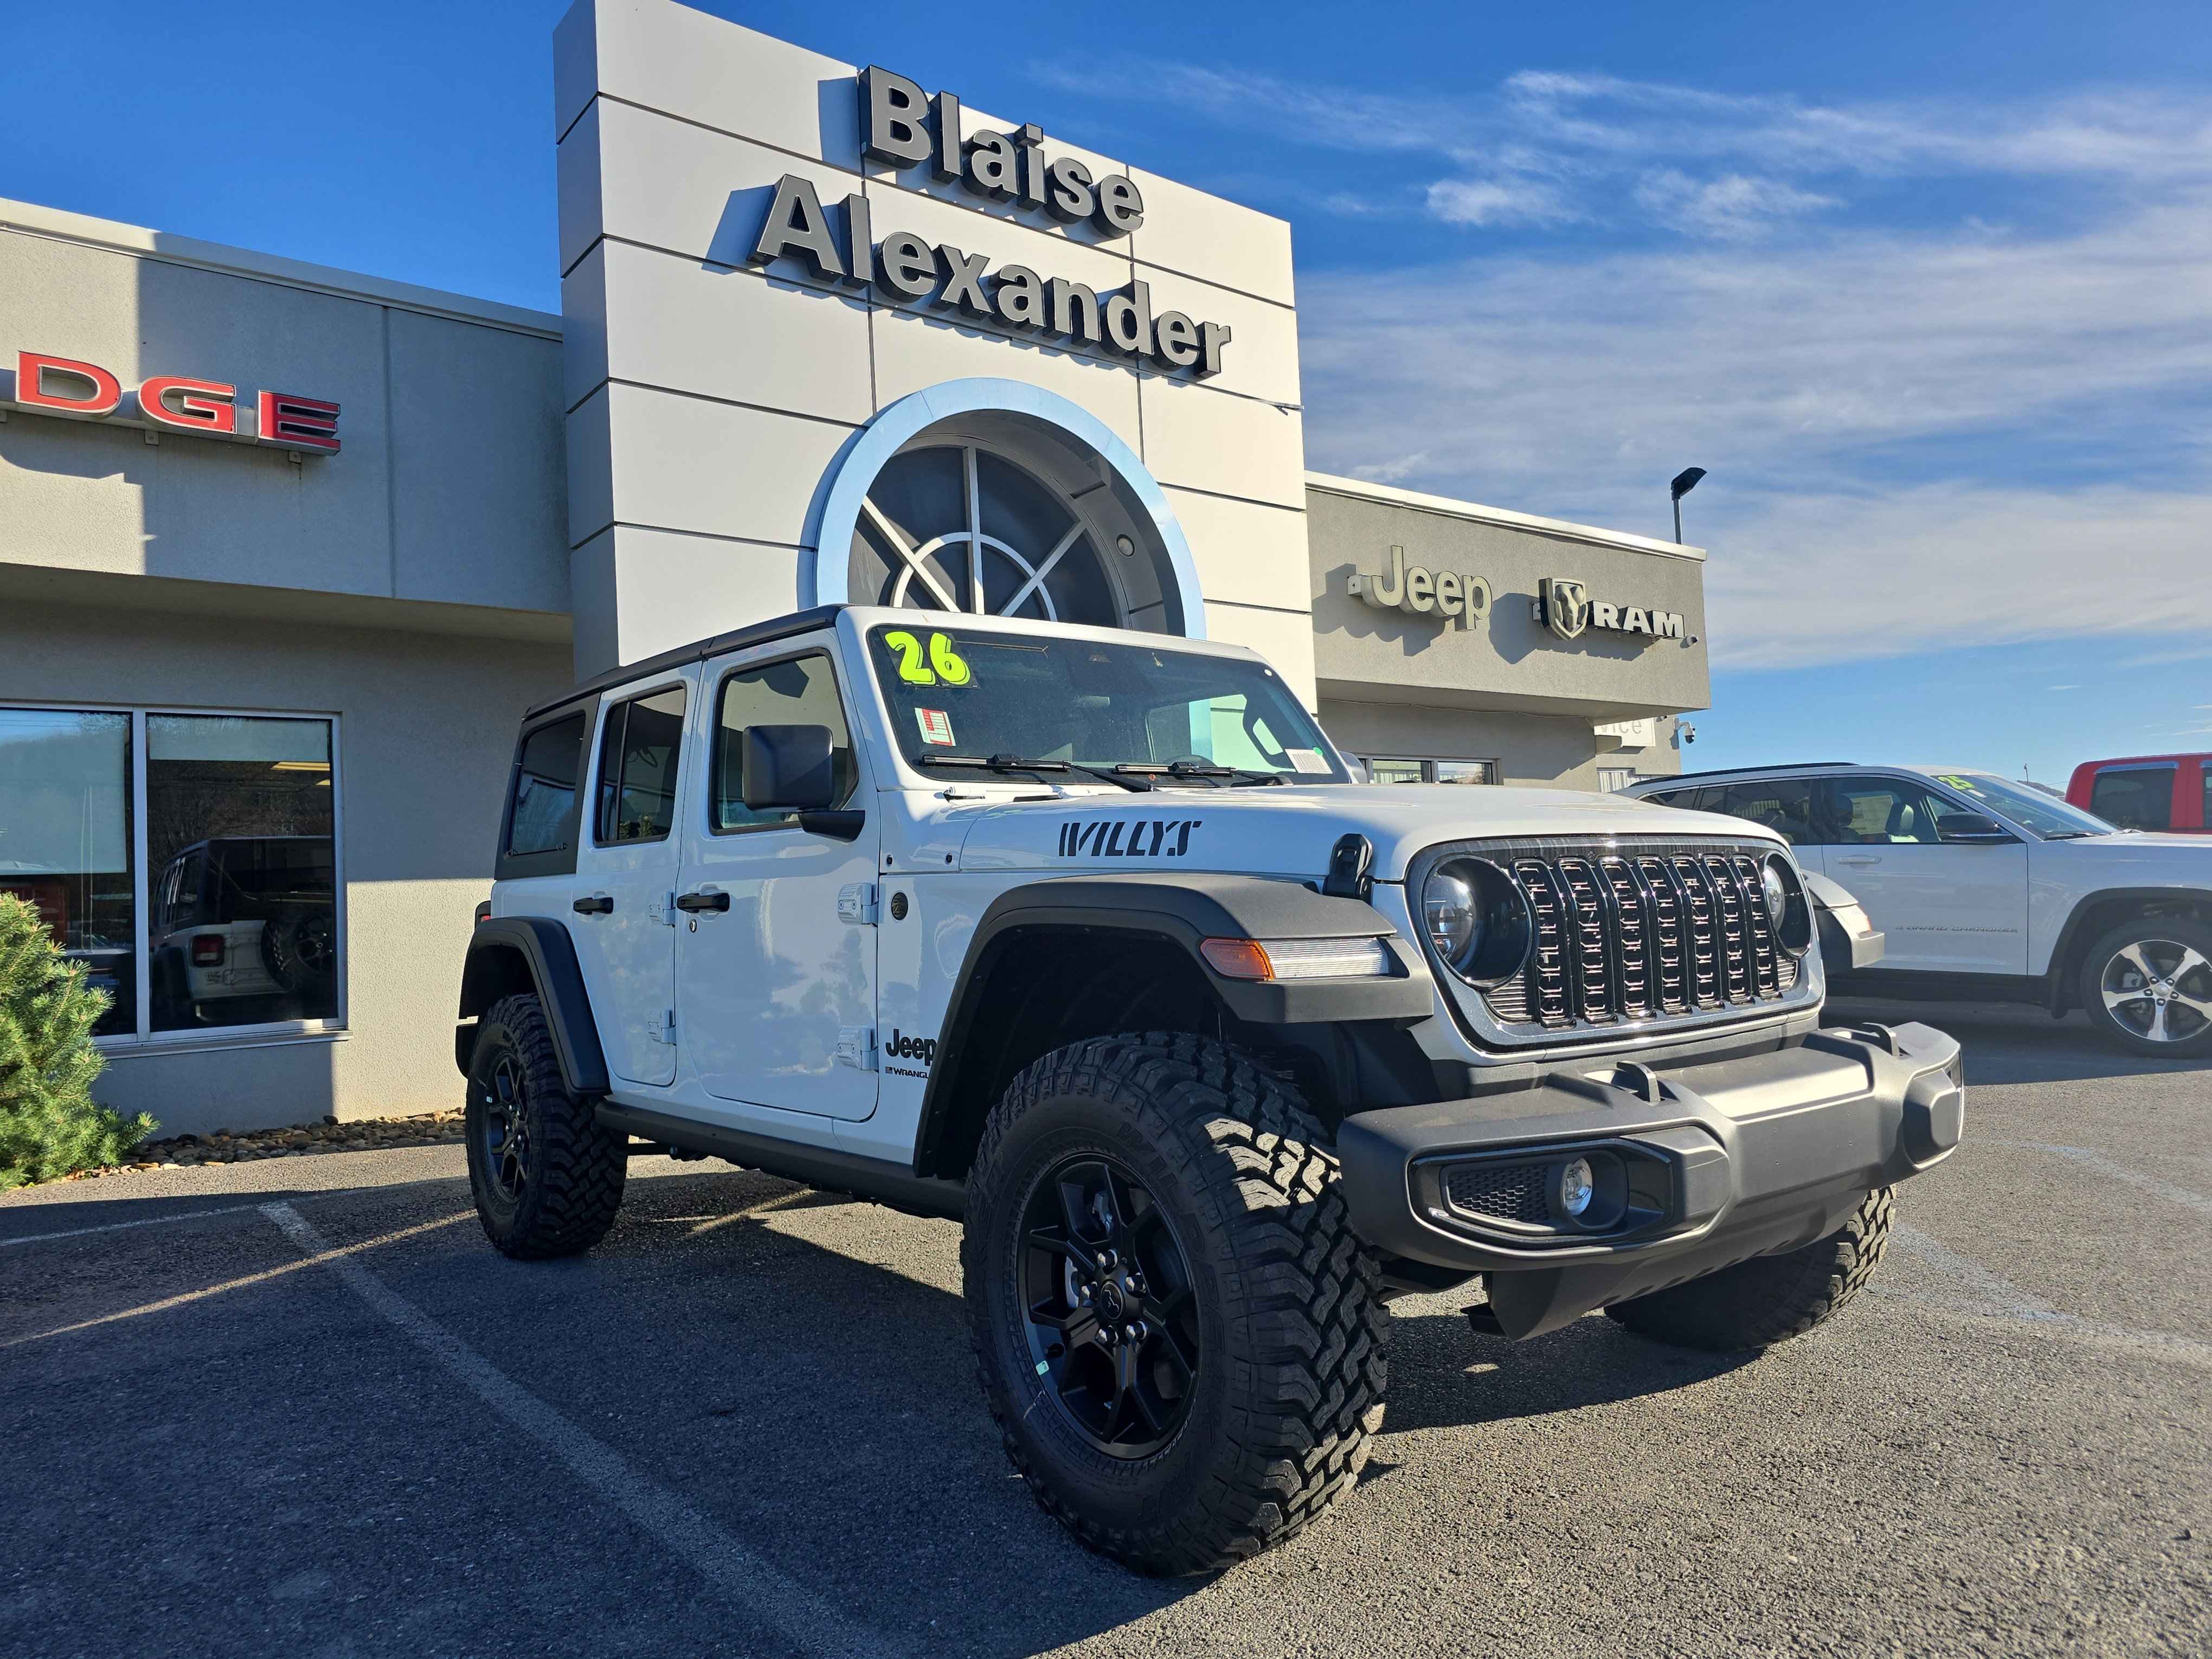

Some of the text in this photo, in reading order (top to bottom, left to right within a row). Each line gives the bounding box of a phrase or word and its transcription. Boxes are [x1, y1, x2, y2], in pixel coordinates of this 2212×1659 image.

[859, 65, 1144, 239] Blaise
[747, 173, 1231, 378] Alexander
[1360, 545, 1493, 631] Jeep
[1592, 600, 1684, 639] RAM
[885, 631, 970, 685] 26
[1938, 775, 1975, 790] 25
[1059, 820, 1203, 857] WILLYS
[885, 1028, 937, 1066] Jeep
